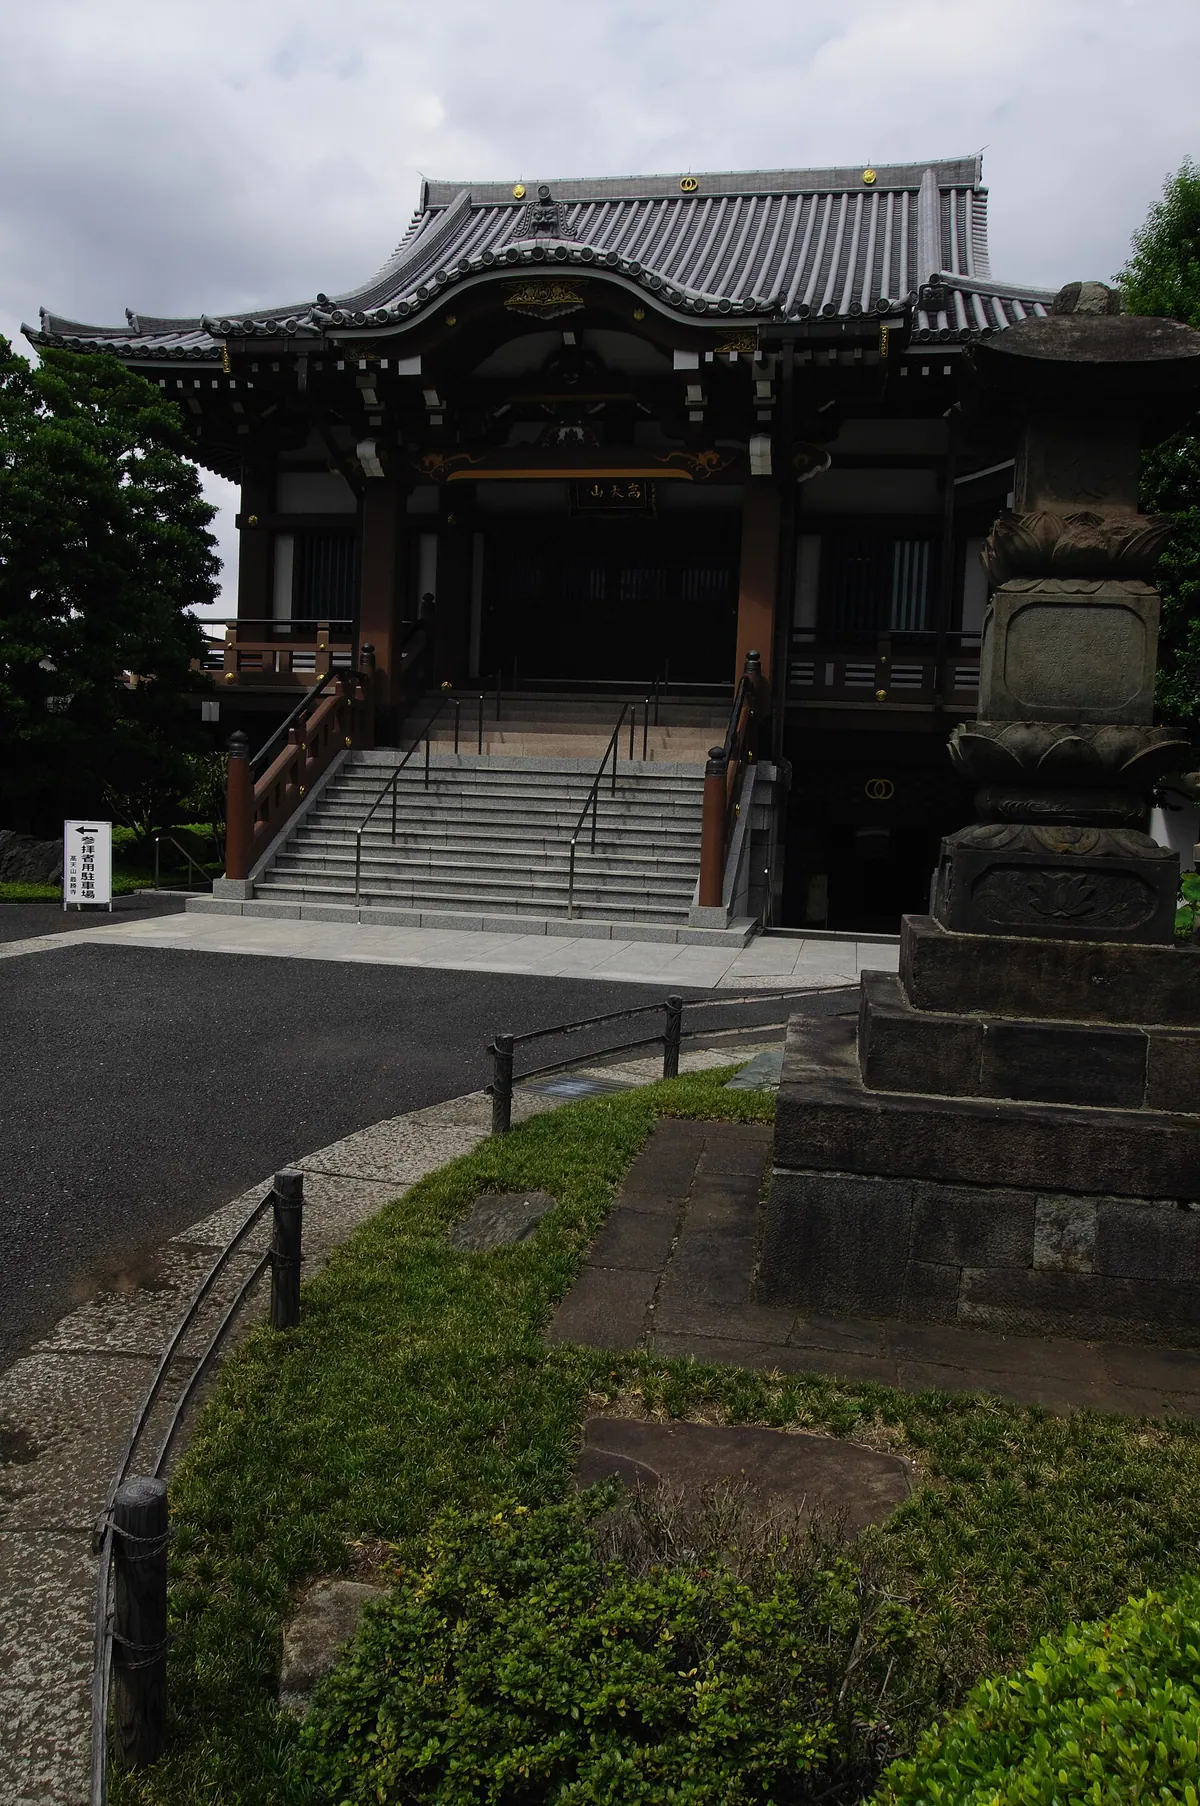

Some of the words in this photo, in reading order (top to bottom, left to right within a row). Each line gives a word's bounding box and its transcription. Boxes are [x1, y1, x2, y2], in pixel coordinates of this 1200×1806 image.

[81, 836, 95, 899] 参拝者用駐車場
